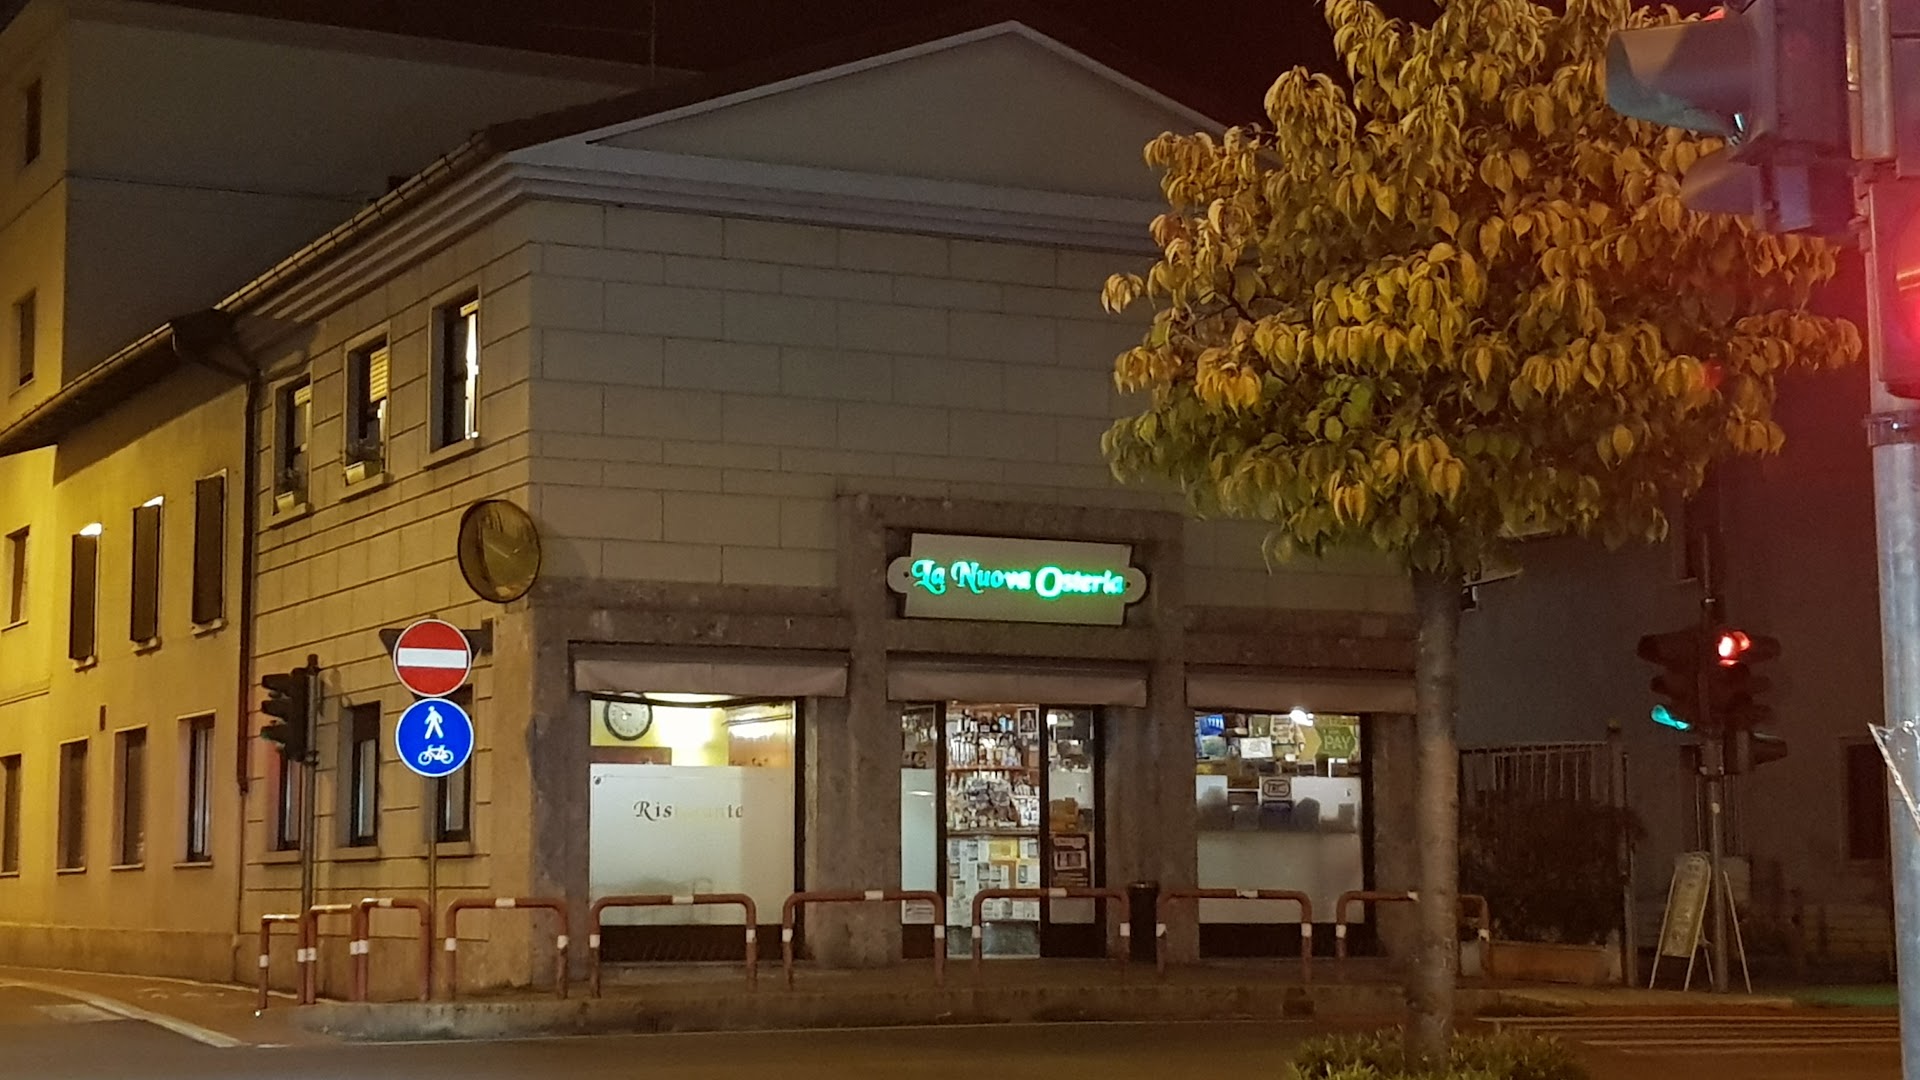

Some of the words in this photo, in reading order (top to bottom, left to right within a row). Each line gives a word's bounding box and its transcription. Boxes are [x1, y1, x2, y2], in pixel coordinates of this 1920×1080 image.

[911, 559, 946, 594] La
[950, 561, 1032, 594] Nuova
[1034, 565, 1125, 598] Osteria
[1324, 735, 1351, 750] PAY
[633, 800, 743, 822] Risnte
